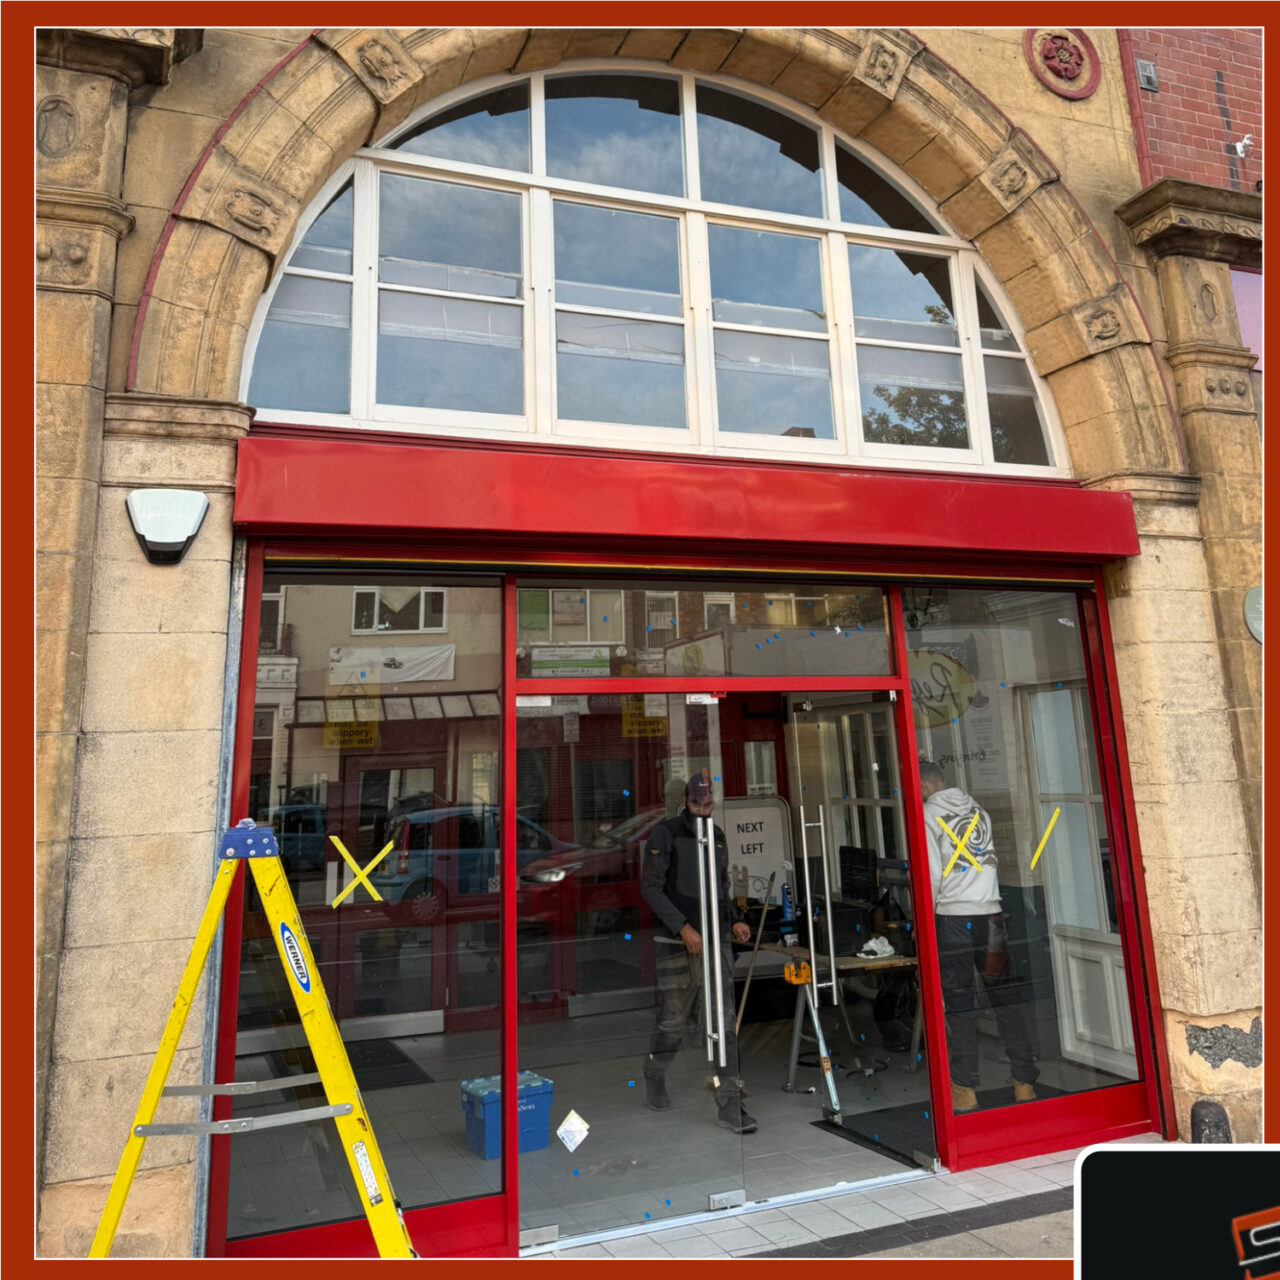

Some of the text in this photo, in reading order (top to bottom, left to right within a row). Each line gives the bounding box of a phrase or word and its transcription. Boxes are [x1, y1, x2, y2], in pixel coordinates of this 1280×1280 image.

[737, 822, 764, 834] NEXT
[741, 843, 764, 855] LEFT
[285, 936, 306, 979] WERNER
